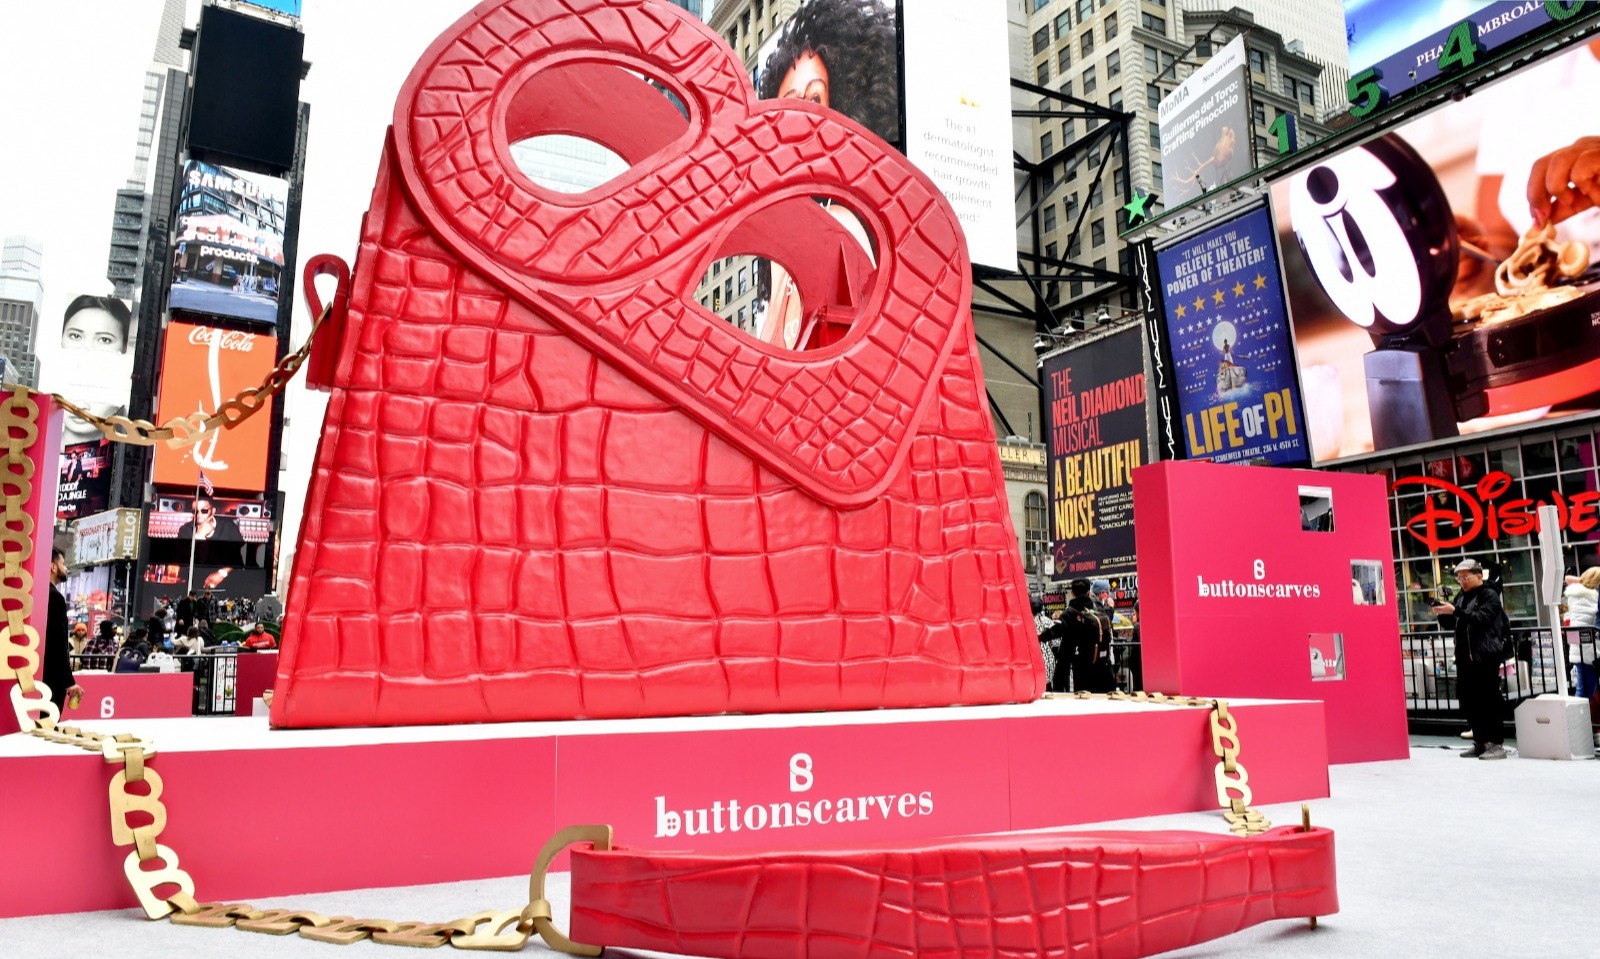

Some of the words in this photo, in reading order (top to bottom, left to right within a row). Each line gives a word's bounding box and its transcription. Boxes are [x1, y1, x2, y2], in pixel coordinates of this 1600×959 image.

[1202, 72, 1215, 83] Now
[1215, 64, 1223, 73] on
[1222, 53, 1236, 68] view
[1160, 85, 1190, 119] MoMA
[1162, 109, 1201, 144] Guillermo
[1200, 97, 1214, 115] del
[1215, 80, 1239, 103] Toro:
[944, 117, 963, 133] The
[966, 123, 976, 136] #1
[1162, 125, 1196, 157] Crafting
[1195, 94, 1239, 132] Pinocchio
[924, 149, 999, 176] recommended
[933, 167, 953, 182] hair
[955, 174, 991, 191] growth
[944, 190, 992, 210] pplement
[200, 245, 260, 265] products.
[1174, 250, 1215, 279] BELIEVE
[1215, 246, 1229, 262] IN
[1230, 236, 1252, 256] THE
[1192, 243, 1206, 257] WILL
[1206, 236, 1224, 251] MAKE
[1224, 230, 1237, 244] YOU
[1166, 272, 1199, 297] POWER
[1200, 266, 1213, 283] OF
[1051, 367, 1073, 400] THE
[1052, 394, 1080, 429] NEIL
[1081, 373, 1146, 420] DIAMOND
[1053, 416, 1104, 457] MUSICAL
[1185, 401, 1245, 457] LIFE
[1241, 404, 1265, 438] OF
[1264, 388, 1297, 440] PI
[1054, 459, 1064, 500] A
[122, 511, 137, 557] HELLO!
[1055, 493, 1097, 541] NOISE
[1197, 575, 1320, 598] buttonscarves
[654, 791, 934, 838] buttonscarves
